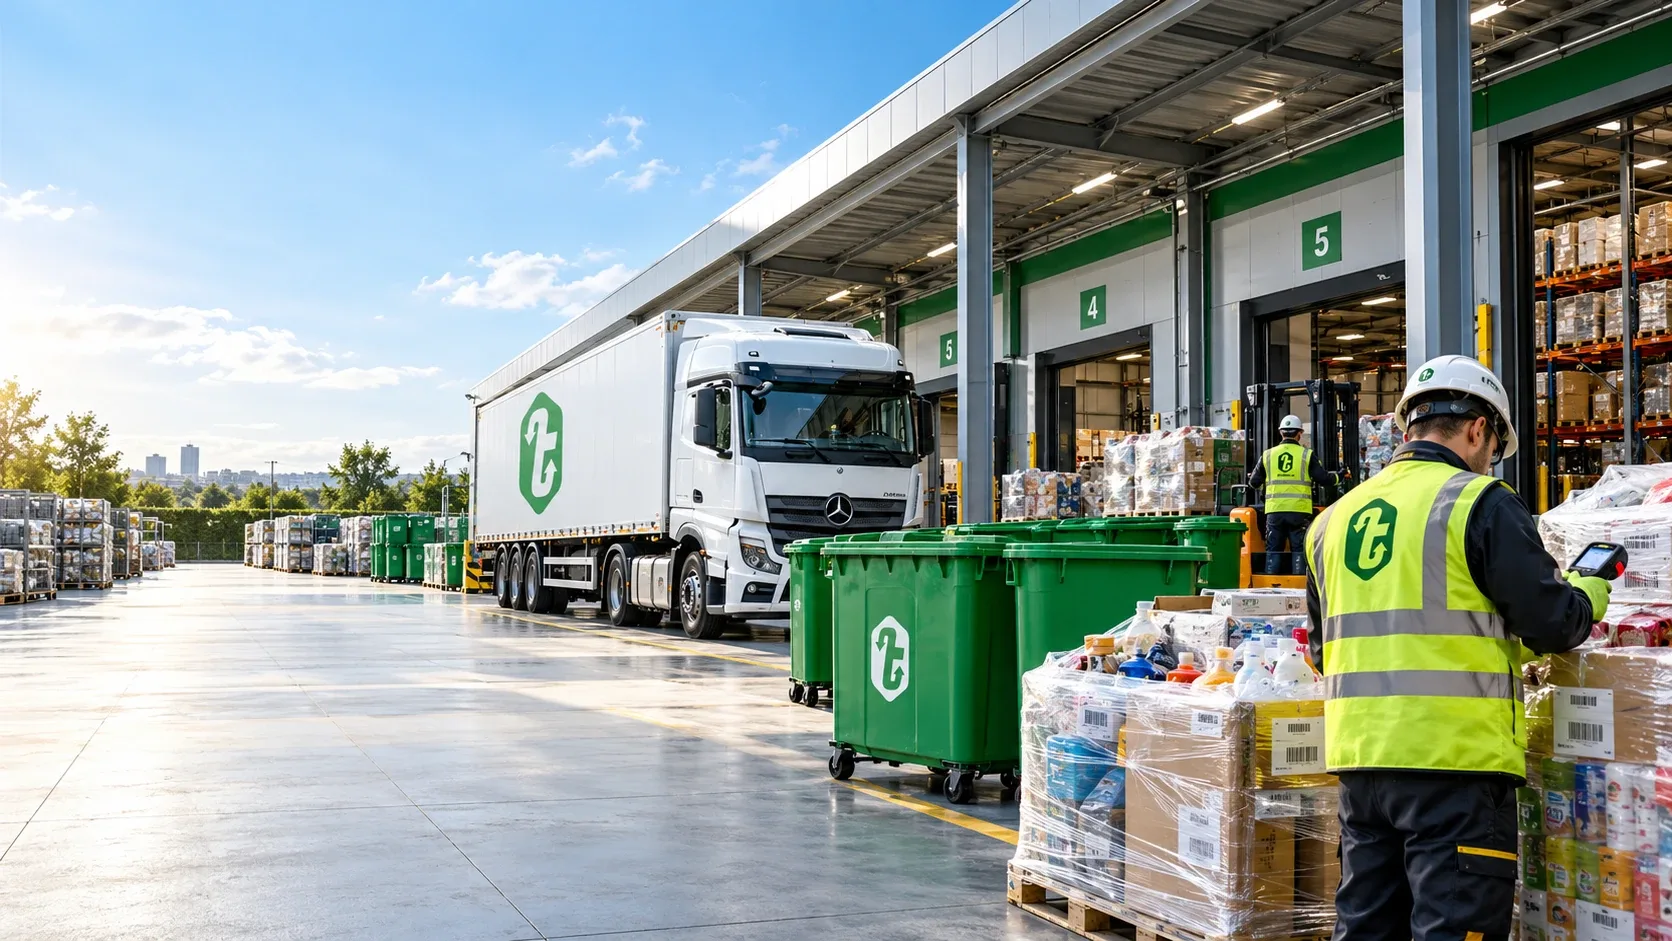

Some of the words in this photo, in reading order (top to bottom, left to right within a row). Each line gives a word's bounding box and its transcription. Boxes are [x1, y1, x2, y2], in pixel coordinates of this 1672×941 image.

[1314, 225, 1329, 257] 5
[1087, 295, 1098, 320] 4
[945, 339, 953, 360] 5
